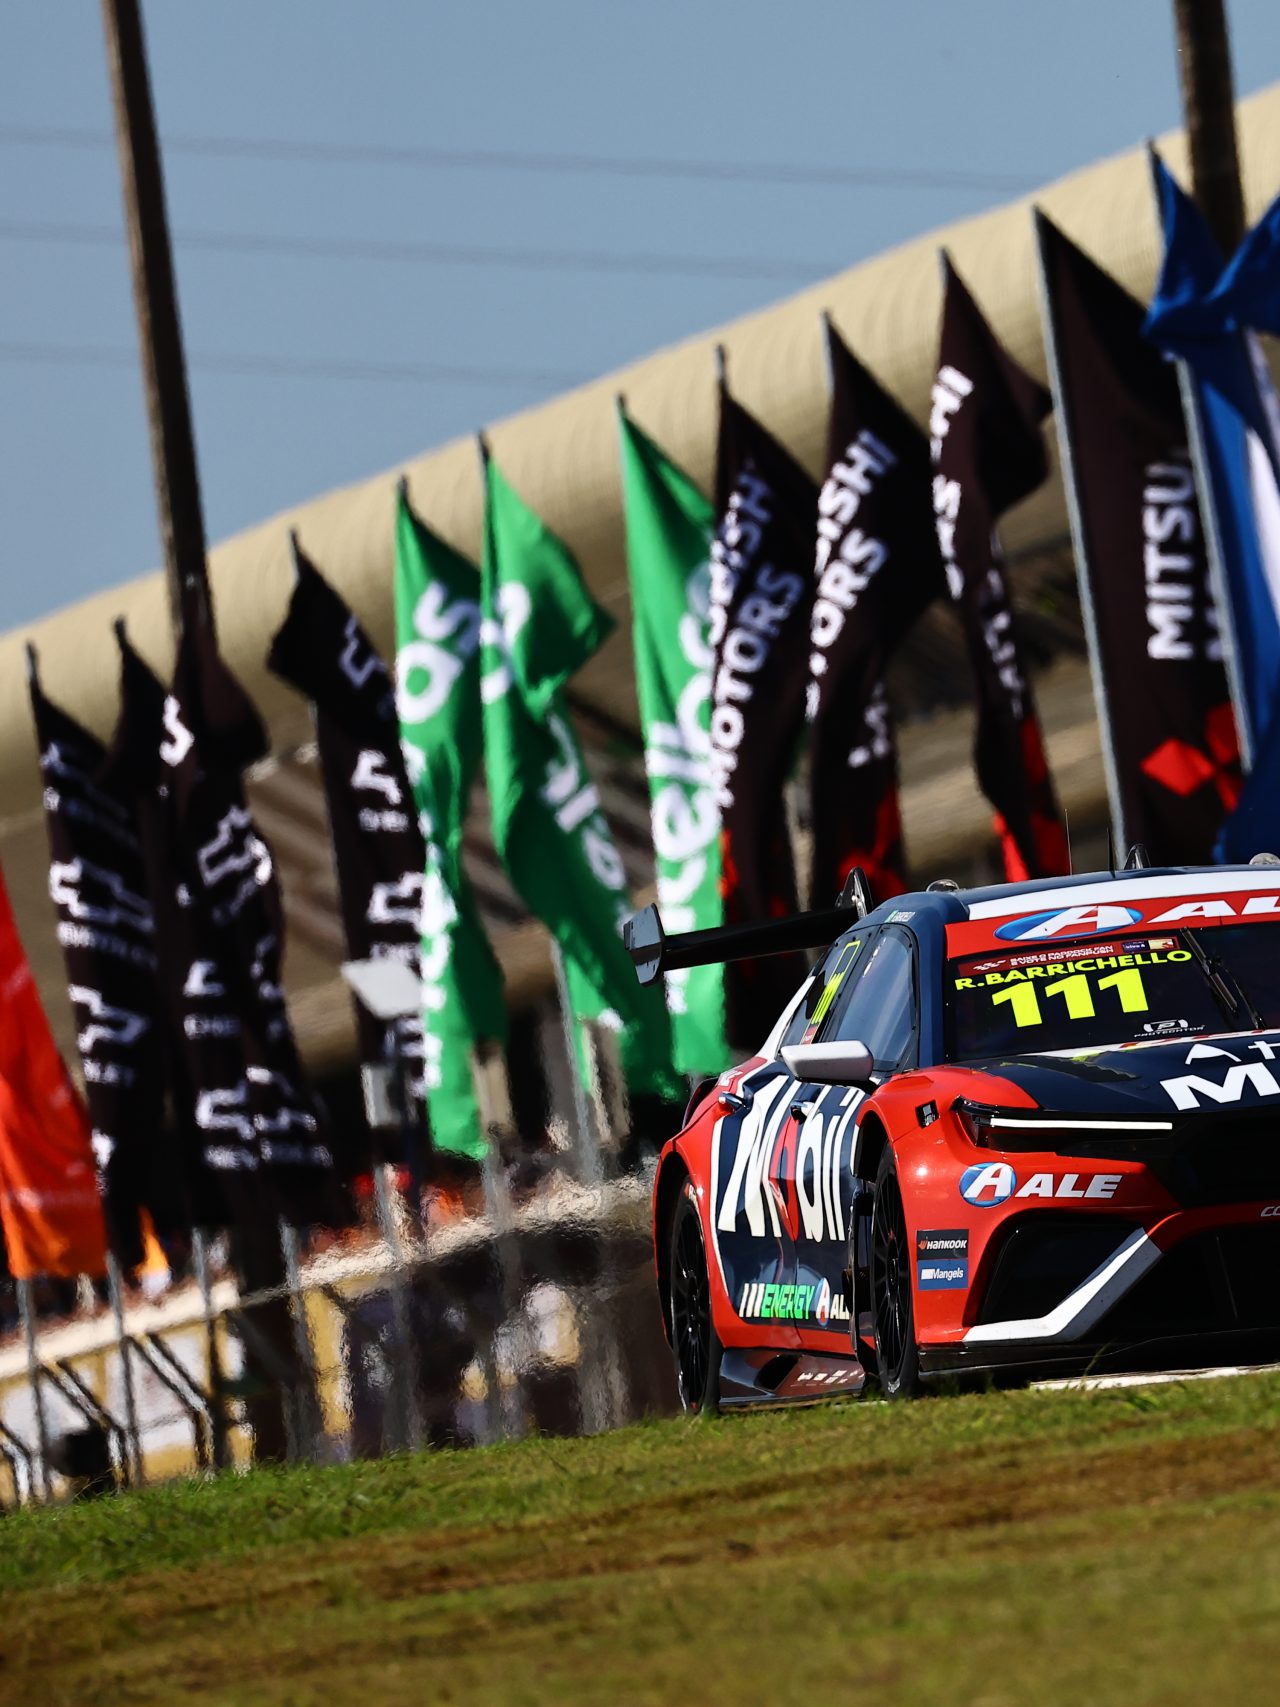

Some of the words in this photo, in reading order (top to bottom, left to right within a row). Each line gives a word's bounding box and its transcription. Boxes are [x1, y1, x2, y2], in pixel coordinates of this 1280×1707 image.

[1142, 462, 1193, 660] MITSU
[954, 949, 1192, 991] R.BARRICHELLO
[991, 968, 1149, 1028] 111
[1014, 1173, 1123, 1199] ALE
[932, 1267, 964, 1281] Mangels
[760, 1283, 815, 1320] ENERGY
